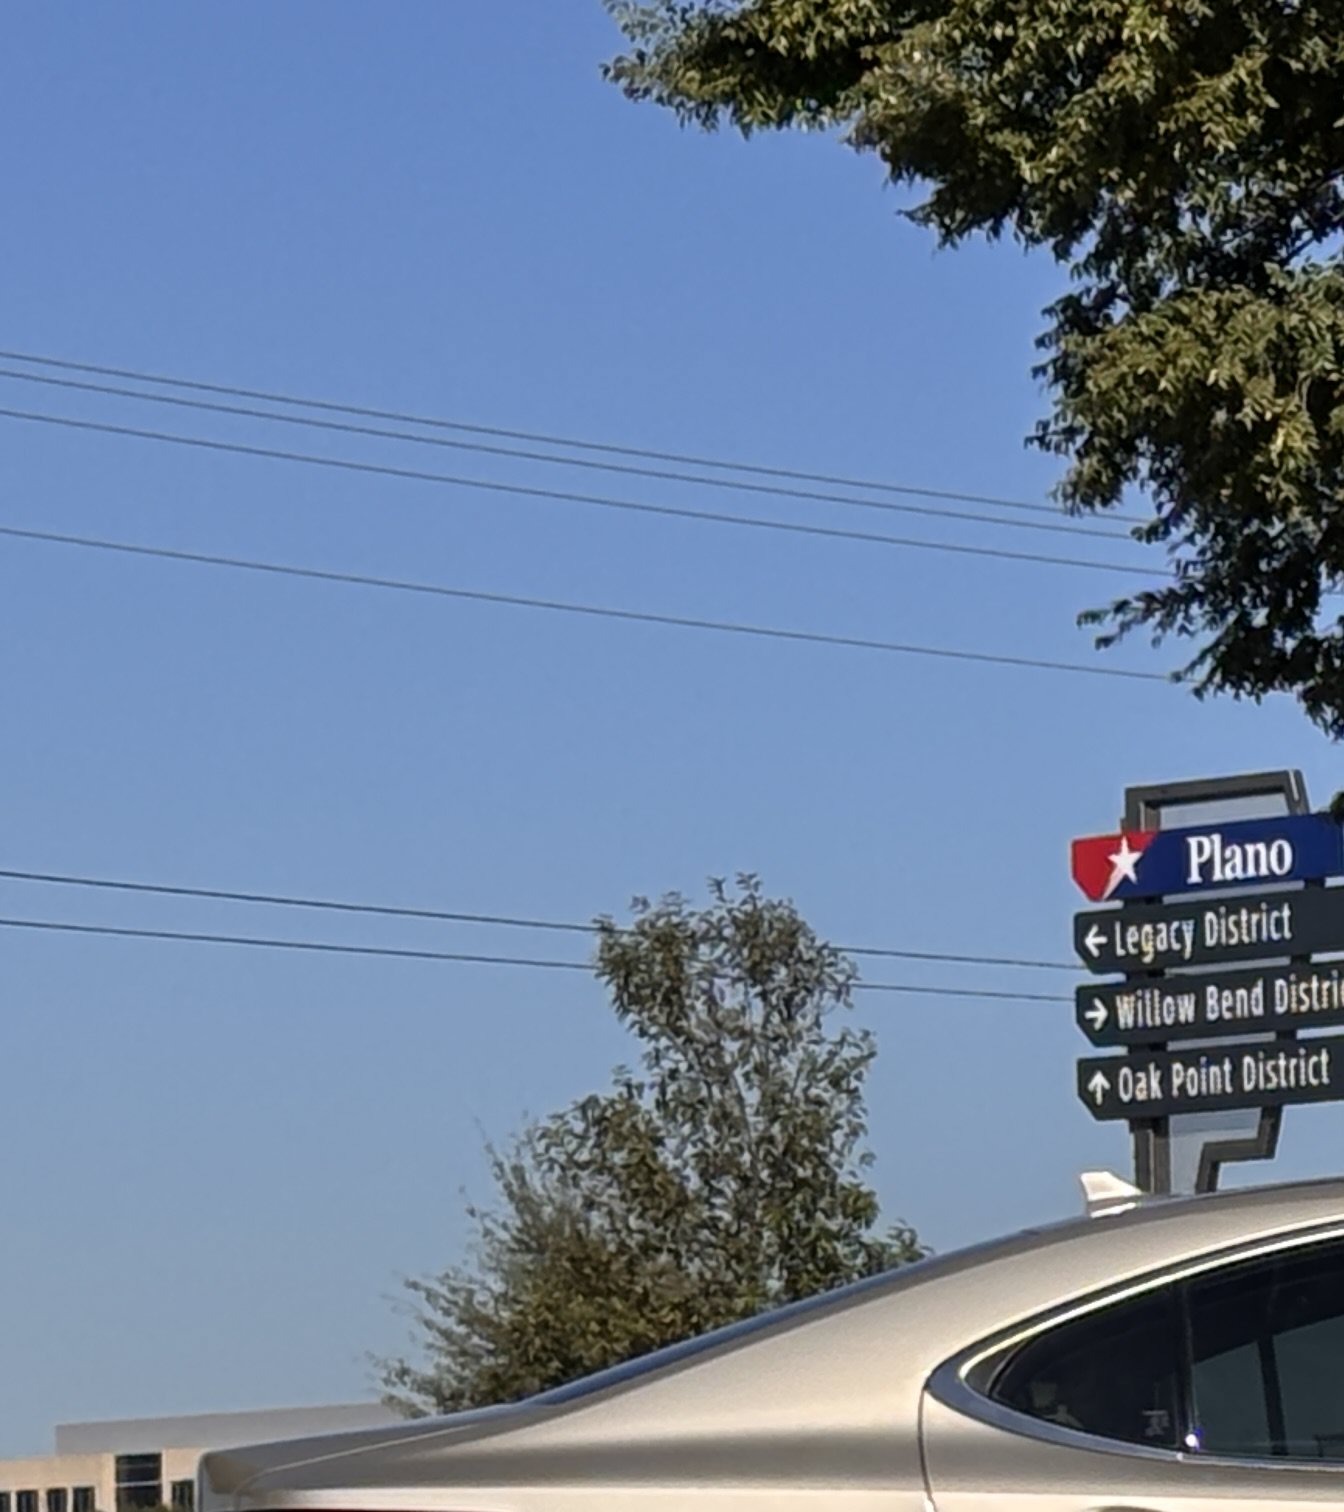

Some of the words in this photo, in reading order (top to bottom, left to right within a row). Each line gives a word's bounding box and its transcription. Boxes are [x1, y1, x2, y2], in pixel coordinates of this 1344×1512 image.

[1186, 832, 1293, 884] Plano
[1114, 919, 1195, 964] Legacy
[1204, 902, 1292, 947] District
[1115, 988, 1196, 1030] Willow
[1205, 978, 1265, 1021] Bend
[1117, 1062, 1163, 1103] Oak
[1171, 1056, 1233, 1097] Point
[1242, 1047, 1330, 1092] District
